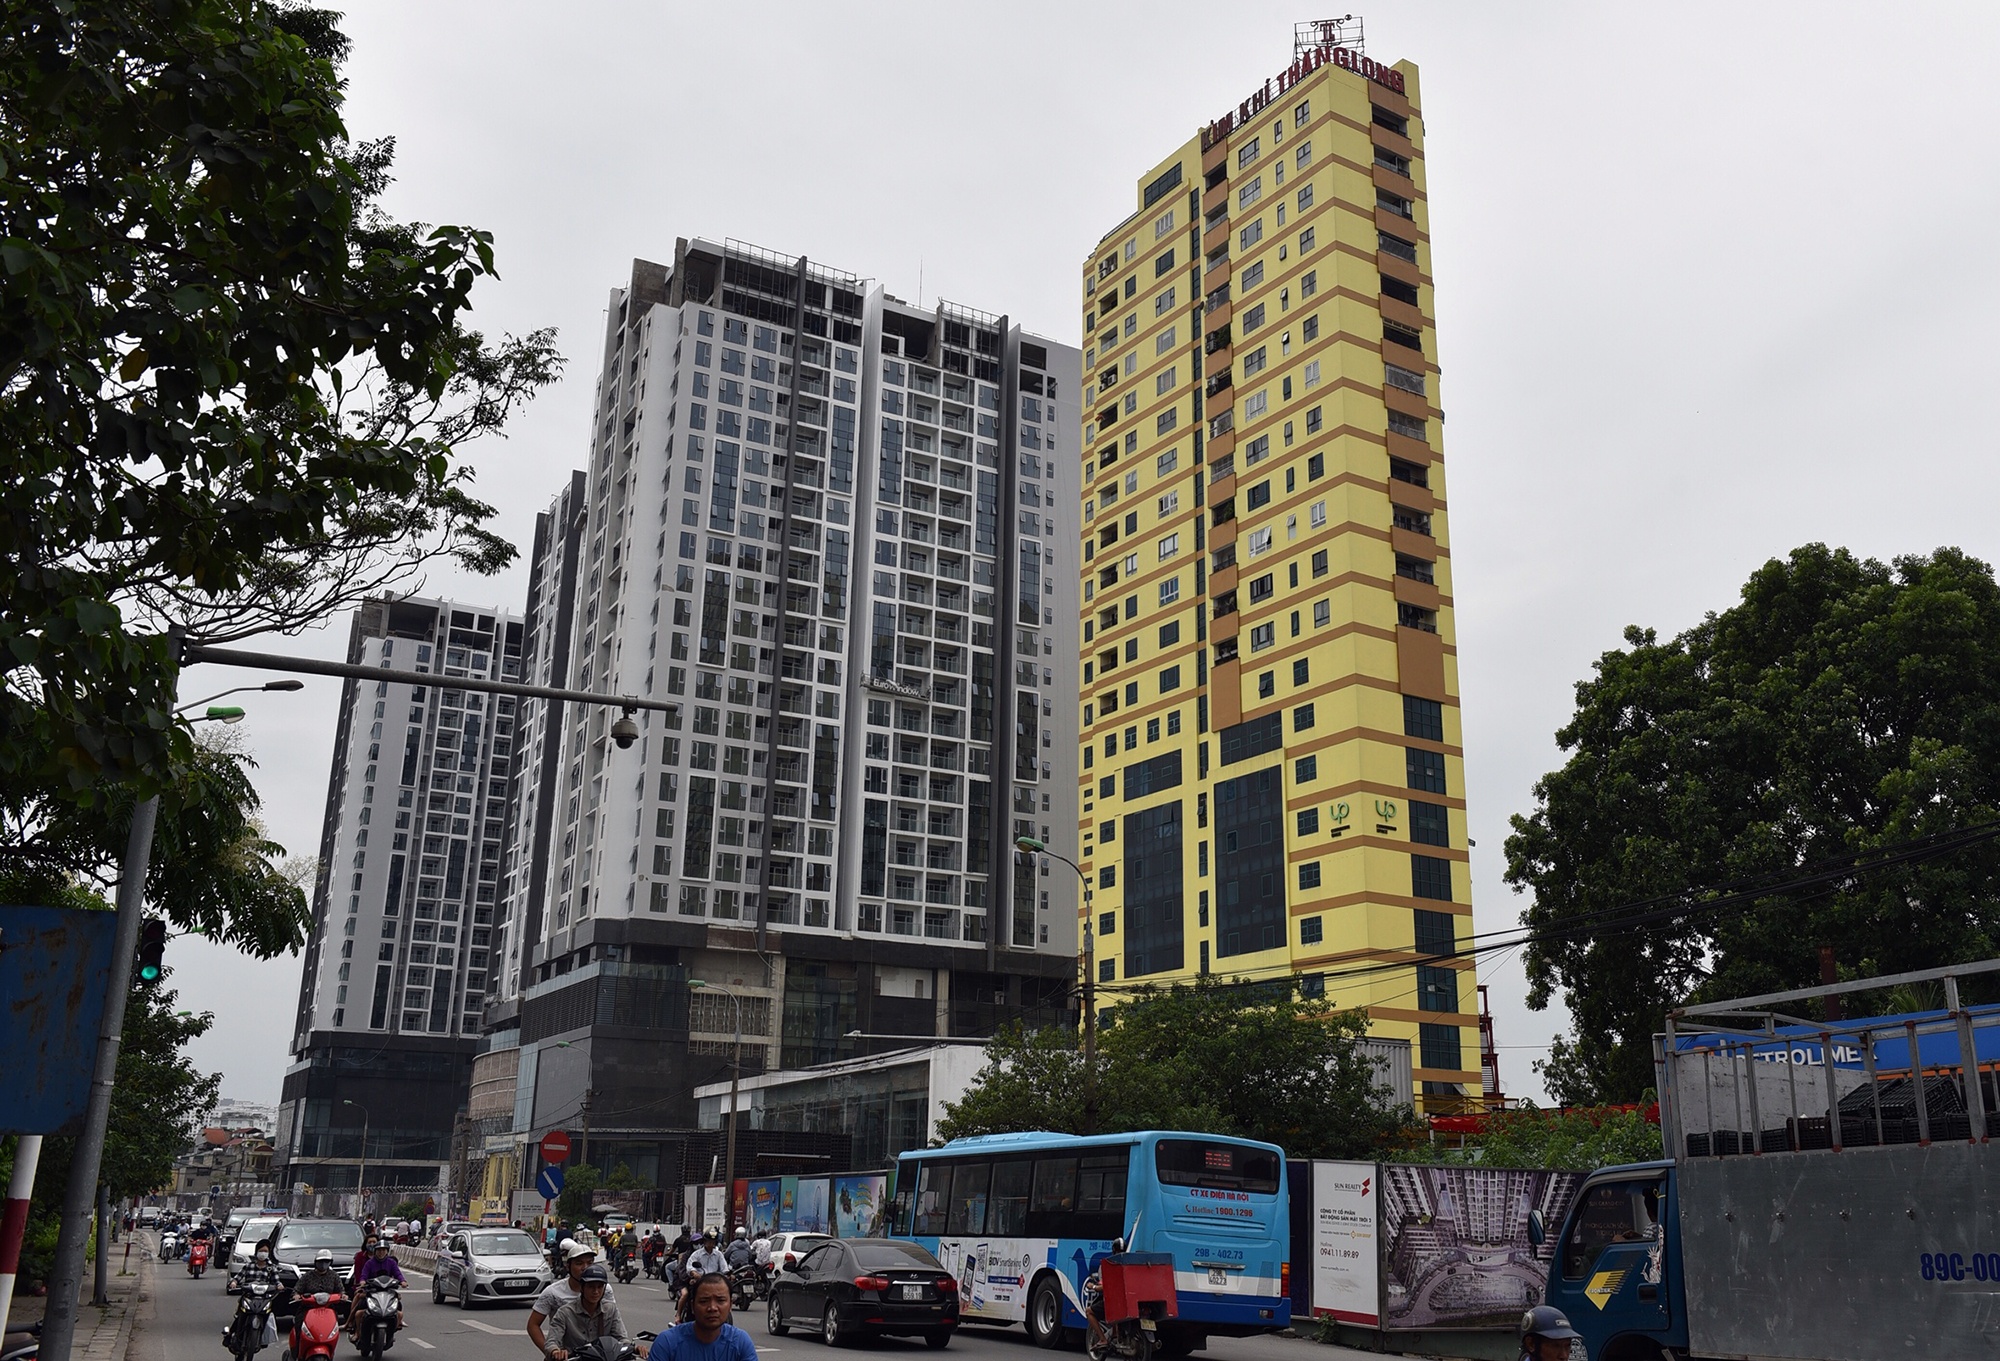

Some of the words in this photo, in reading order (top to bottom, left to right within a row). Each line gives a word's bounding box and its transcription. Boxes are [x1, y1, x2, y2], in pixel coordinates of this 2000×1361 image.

[1200, 1190, 1209, 1198] XE
[1195, 1248, 1210, 1258] 29B
[1217, 1249, 1243, 1260] 402.73
